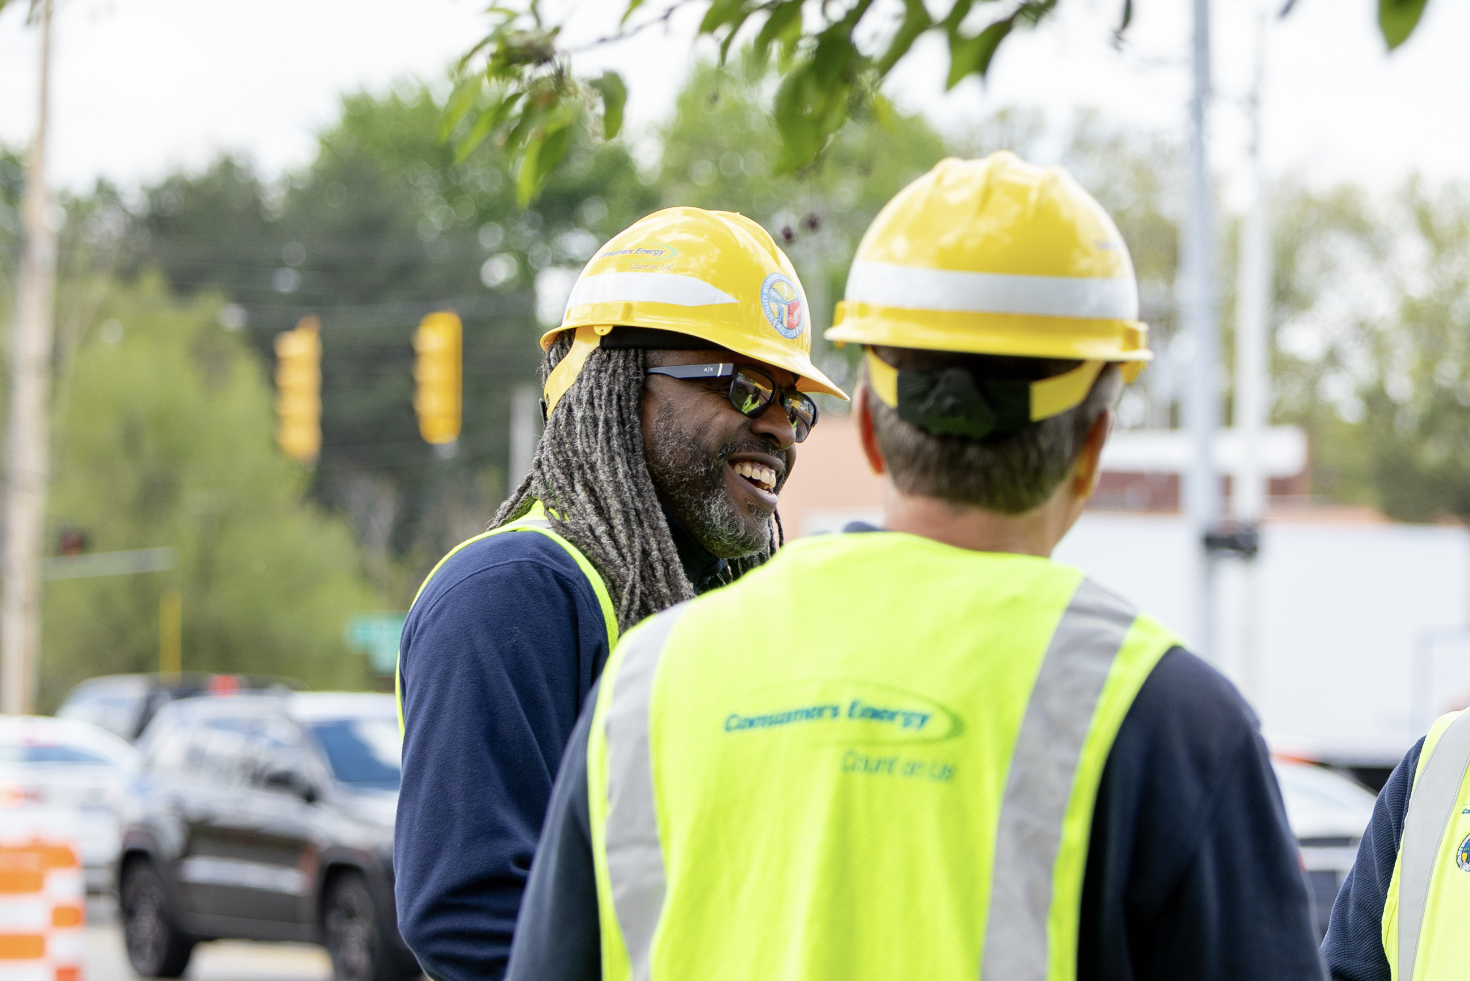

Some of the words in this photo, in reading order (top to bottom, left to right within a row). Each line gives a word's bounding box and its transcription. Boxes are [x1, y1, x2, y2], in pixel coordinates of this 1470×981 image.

[635, 247, 666, 257] Energy
[629, 262, 649, 270] Count
[723, 704, 840, 732] Consumers
[847, 698, 932, 732] Energy
[841, 750, 899, 776] Count
